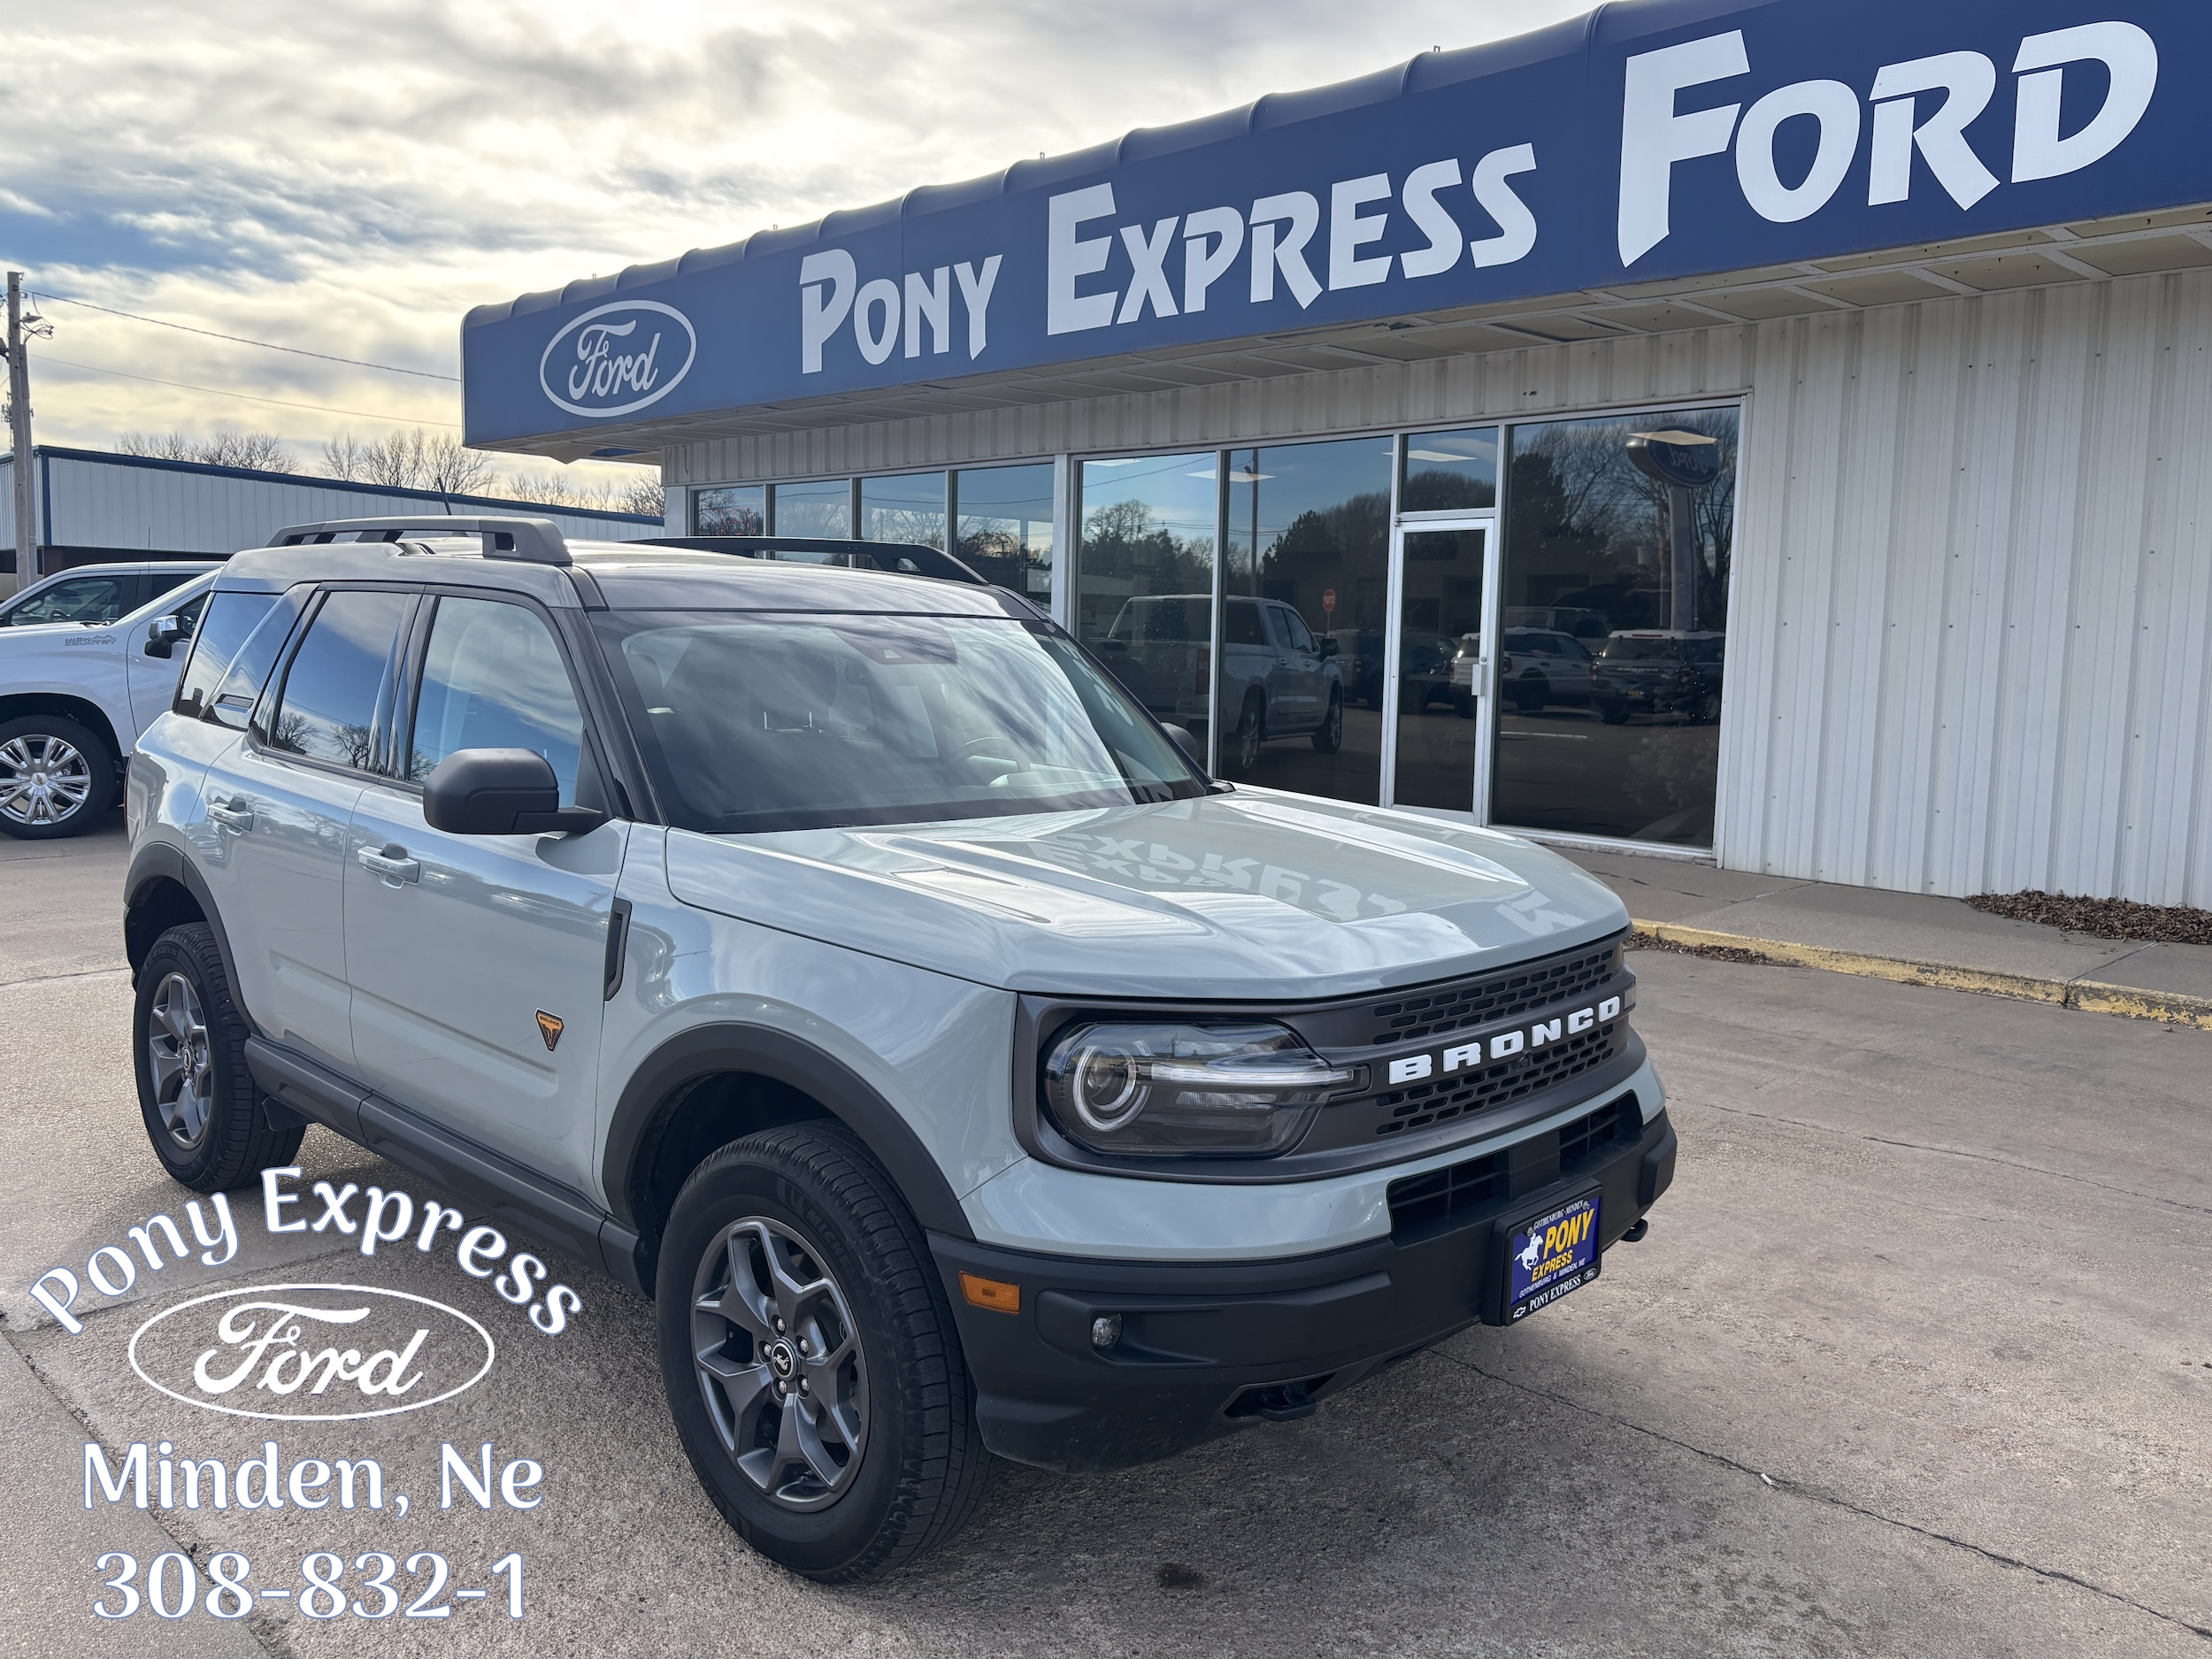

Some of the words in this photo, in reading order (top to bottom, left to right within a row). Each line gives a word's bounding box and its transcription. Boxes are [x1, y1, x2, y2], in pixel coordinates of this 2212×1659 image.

[799, 248, 1003, 375] PONY
[1047, 142, 1538, 337] EXPRESS
[1617, 20, 2158, 268] FORD
[569, 319, 661, 401] Ford
[1389, 995, 1620, 1085] BRONCO
[1543, 1208, 1594, 1260] PONY
[1518, 1274, 1552, 1298] GOTHENBURG
[1578, 1257, 1586, 1268] NE
[1532, 1248, 1573, 1282] EXPRESS
[1529, 1289, 1551, 1311] PONY
[1550, 1275, 1581, 1301] EXPRESS
